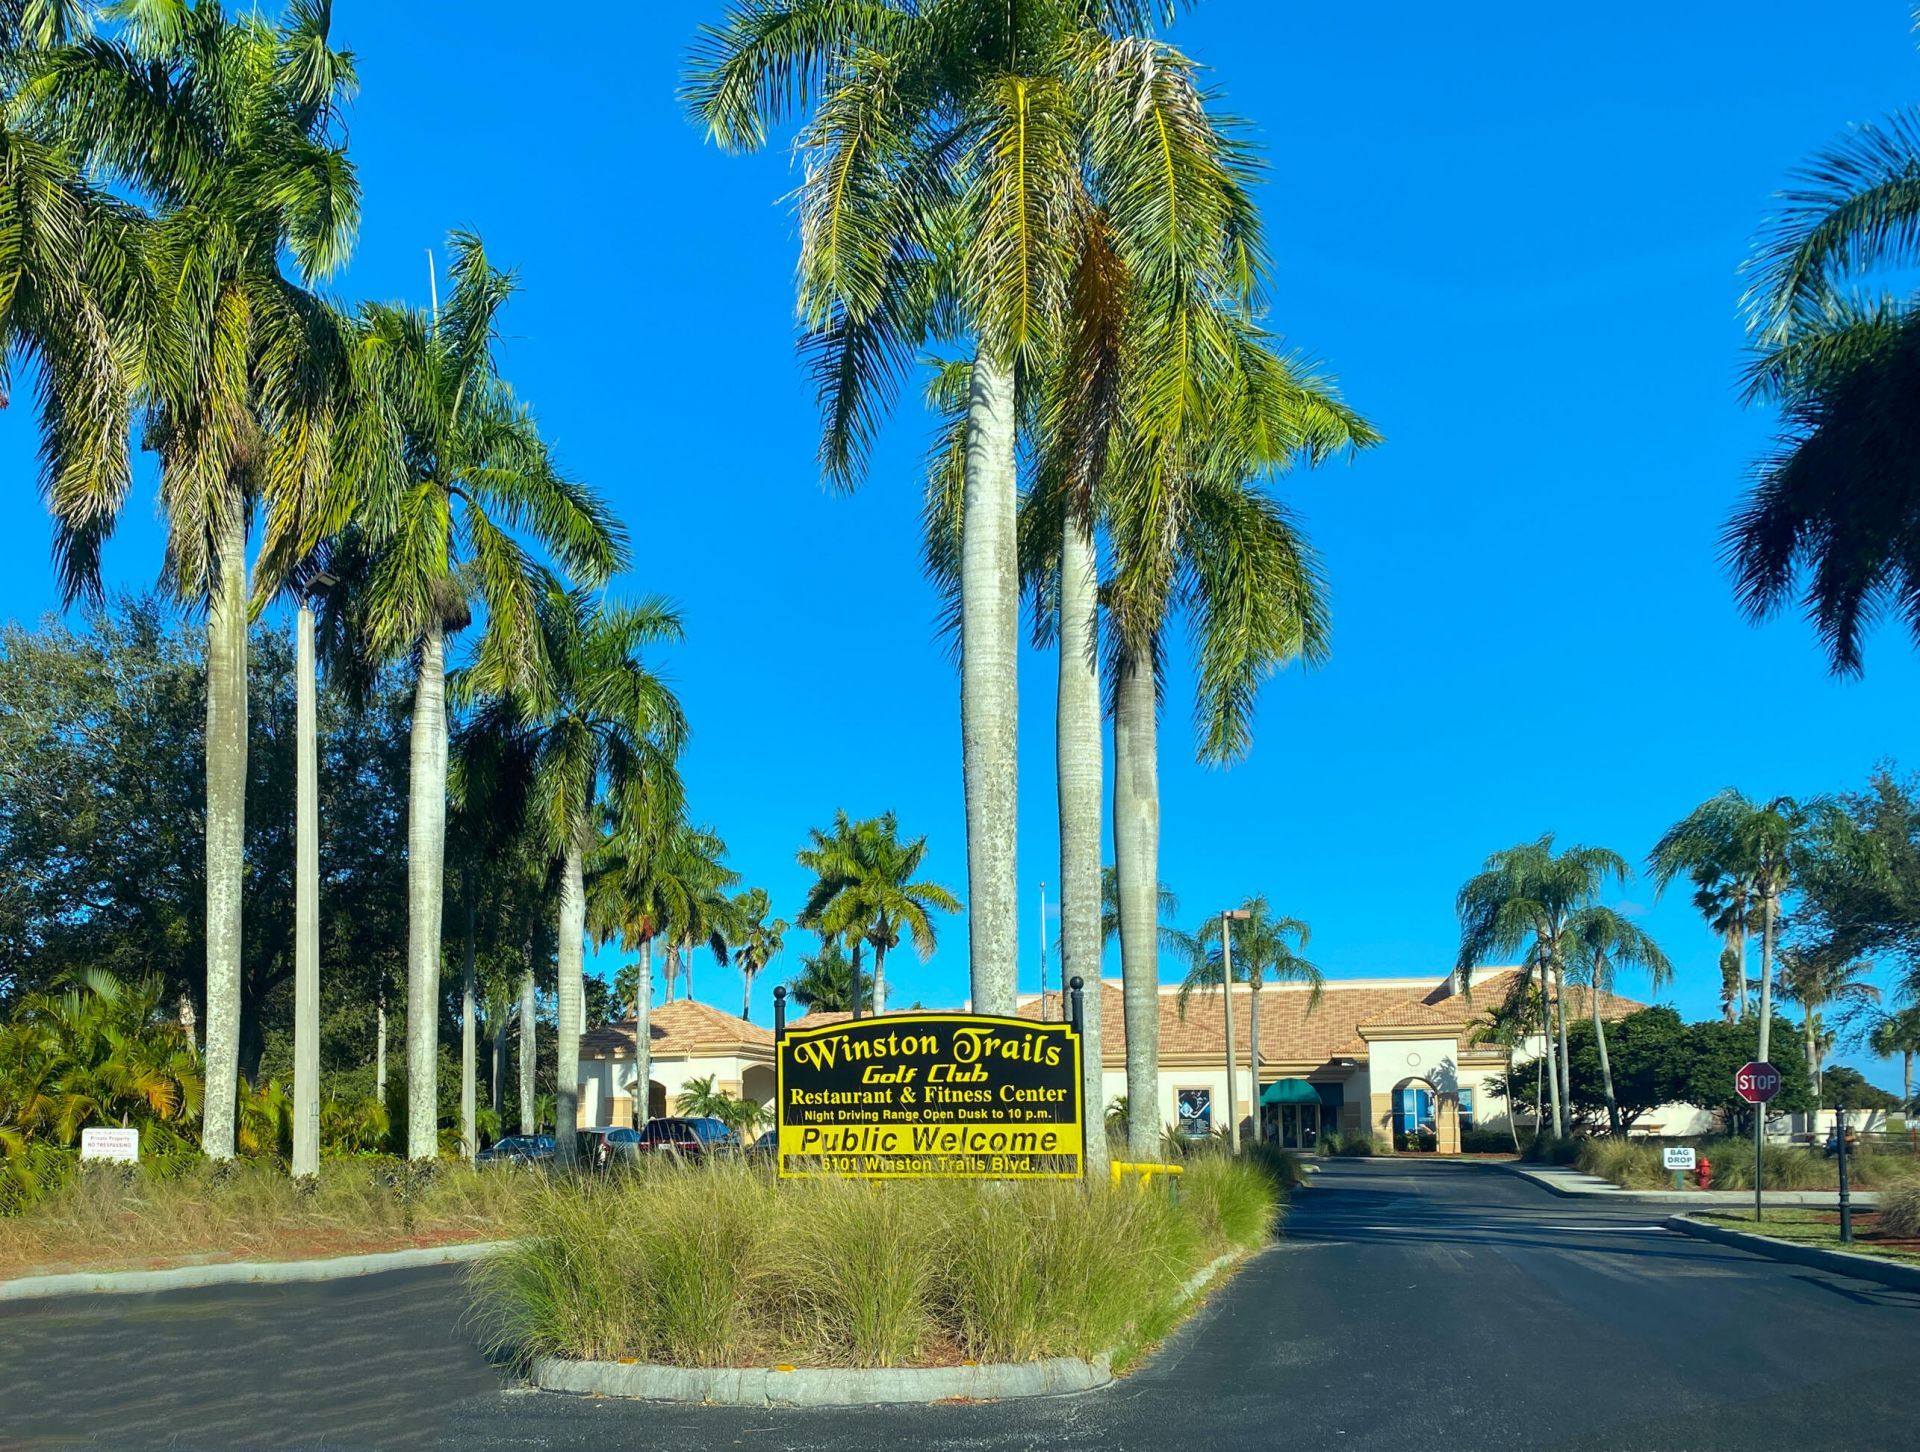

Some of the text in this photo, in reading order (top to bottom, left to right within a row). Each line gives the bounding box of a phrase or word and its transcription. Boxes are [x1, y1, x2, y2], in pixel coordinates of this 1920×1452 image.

[794, 1027, 1062, 1072] Winston Trails
[862, 1063, 989, 1084] Golf Club
[1740, 1075, 1777, 1090] STOP
[790, 1084, 1067, 1105] Restaurant & Fitness Center
[838, 1110, 879, 1121] Driving
[882, 1109, 919, 1121] Range
[923, 1109, 954, 1121] Open
[958, 1108, 988, 1119] Dusk
[992, 1109, 1004, 1119] to
[1008, 1108, 1022, 1119] 10
[1025, 1109, 1052, 1120] p.m.
[800, 1126, 1057, 1152] Public Welcome
[822, 1157, 857, 1171] 6101
[938, 1156, 986, 1171] Trails
[992, 1156, 1036, 1171] Blvd.
